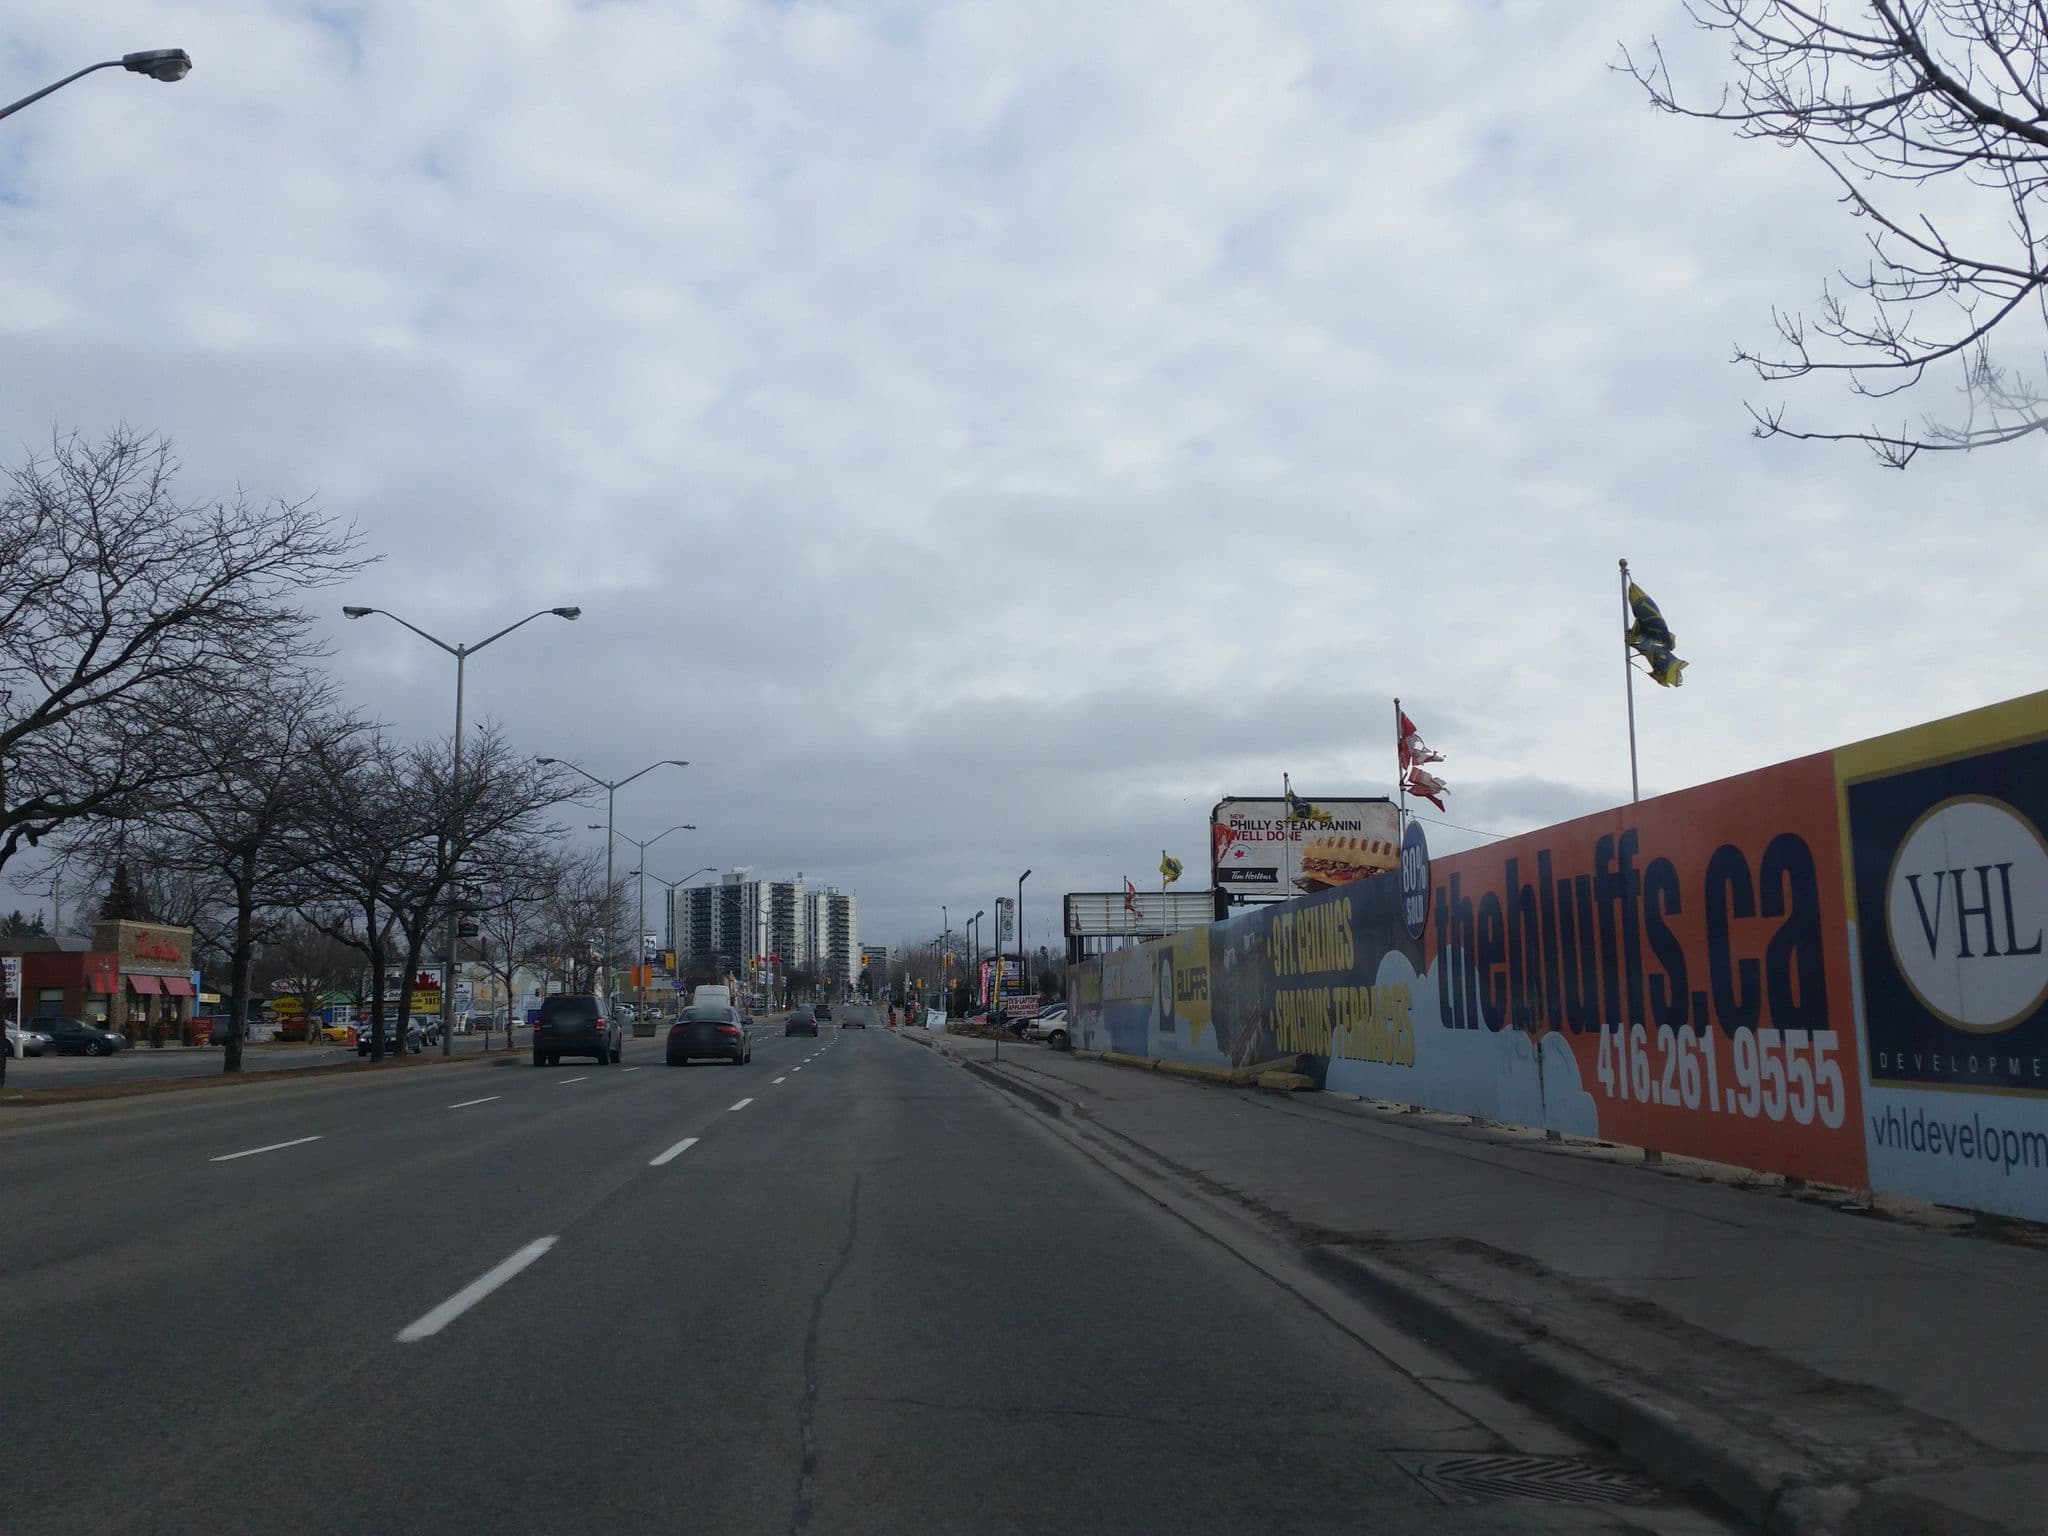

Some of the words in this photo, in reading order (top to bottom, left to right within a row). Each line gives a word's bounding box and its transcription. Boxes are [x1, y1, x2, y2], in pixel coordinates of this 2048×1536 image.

[1230, 820, 1272, 831] PHILLY
[1275, 820, 1316, 831] STEAK
[1320, 820, 1362, 831] PANINI
[1231, 831, 1263, 842] WELL
[1266, 831, 1302, 842] DONE
[1231, 870, 1244, 881] Tim
[1245, 870, 1272, 881] Hortons
[1402, 846, 1427, 893] 80%
[1272, 914, 1282, 977] 9
[1296, 897, 1354, 975] CEILINGS
[1406, 894, 1424, 923] SOLD
[1434, 827, 1829, 1042] thebluffs.ca
[1905, 862, 2043, 960] VHL
[1274, 985, 1332, 1057] SPACIOUS
[1332, 984, 1416, 1067] TERRACES
[1598, 1023, 1845, 1129] 416.261.9555
